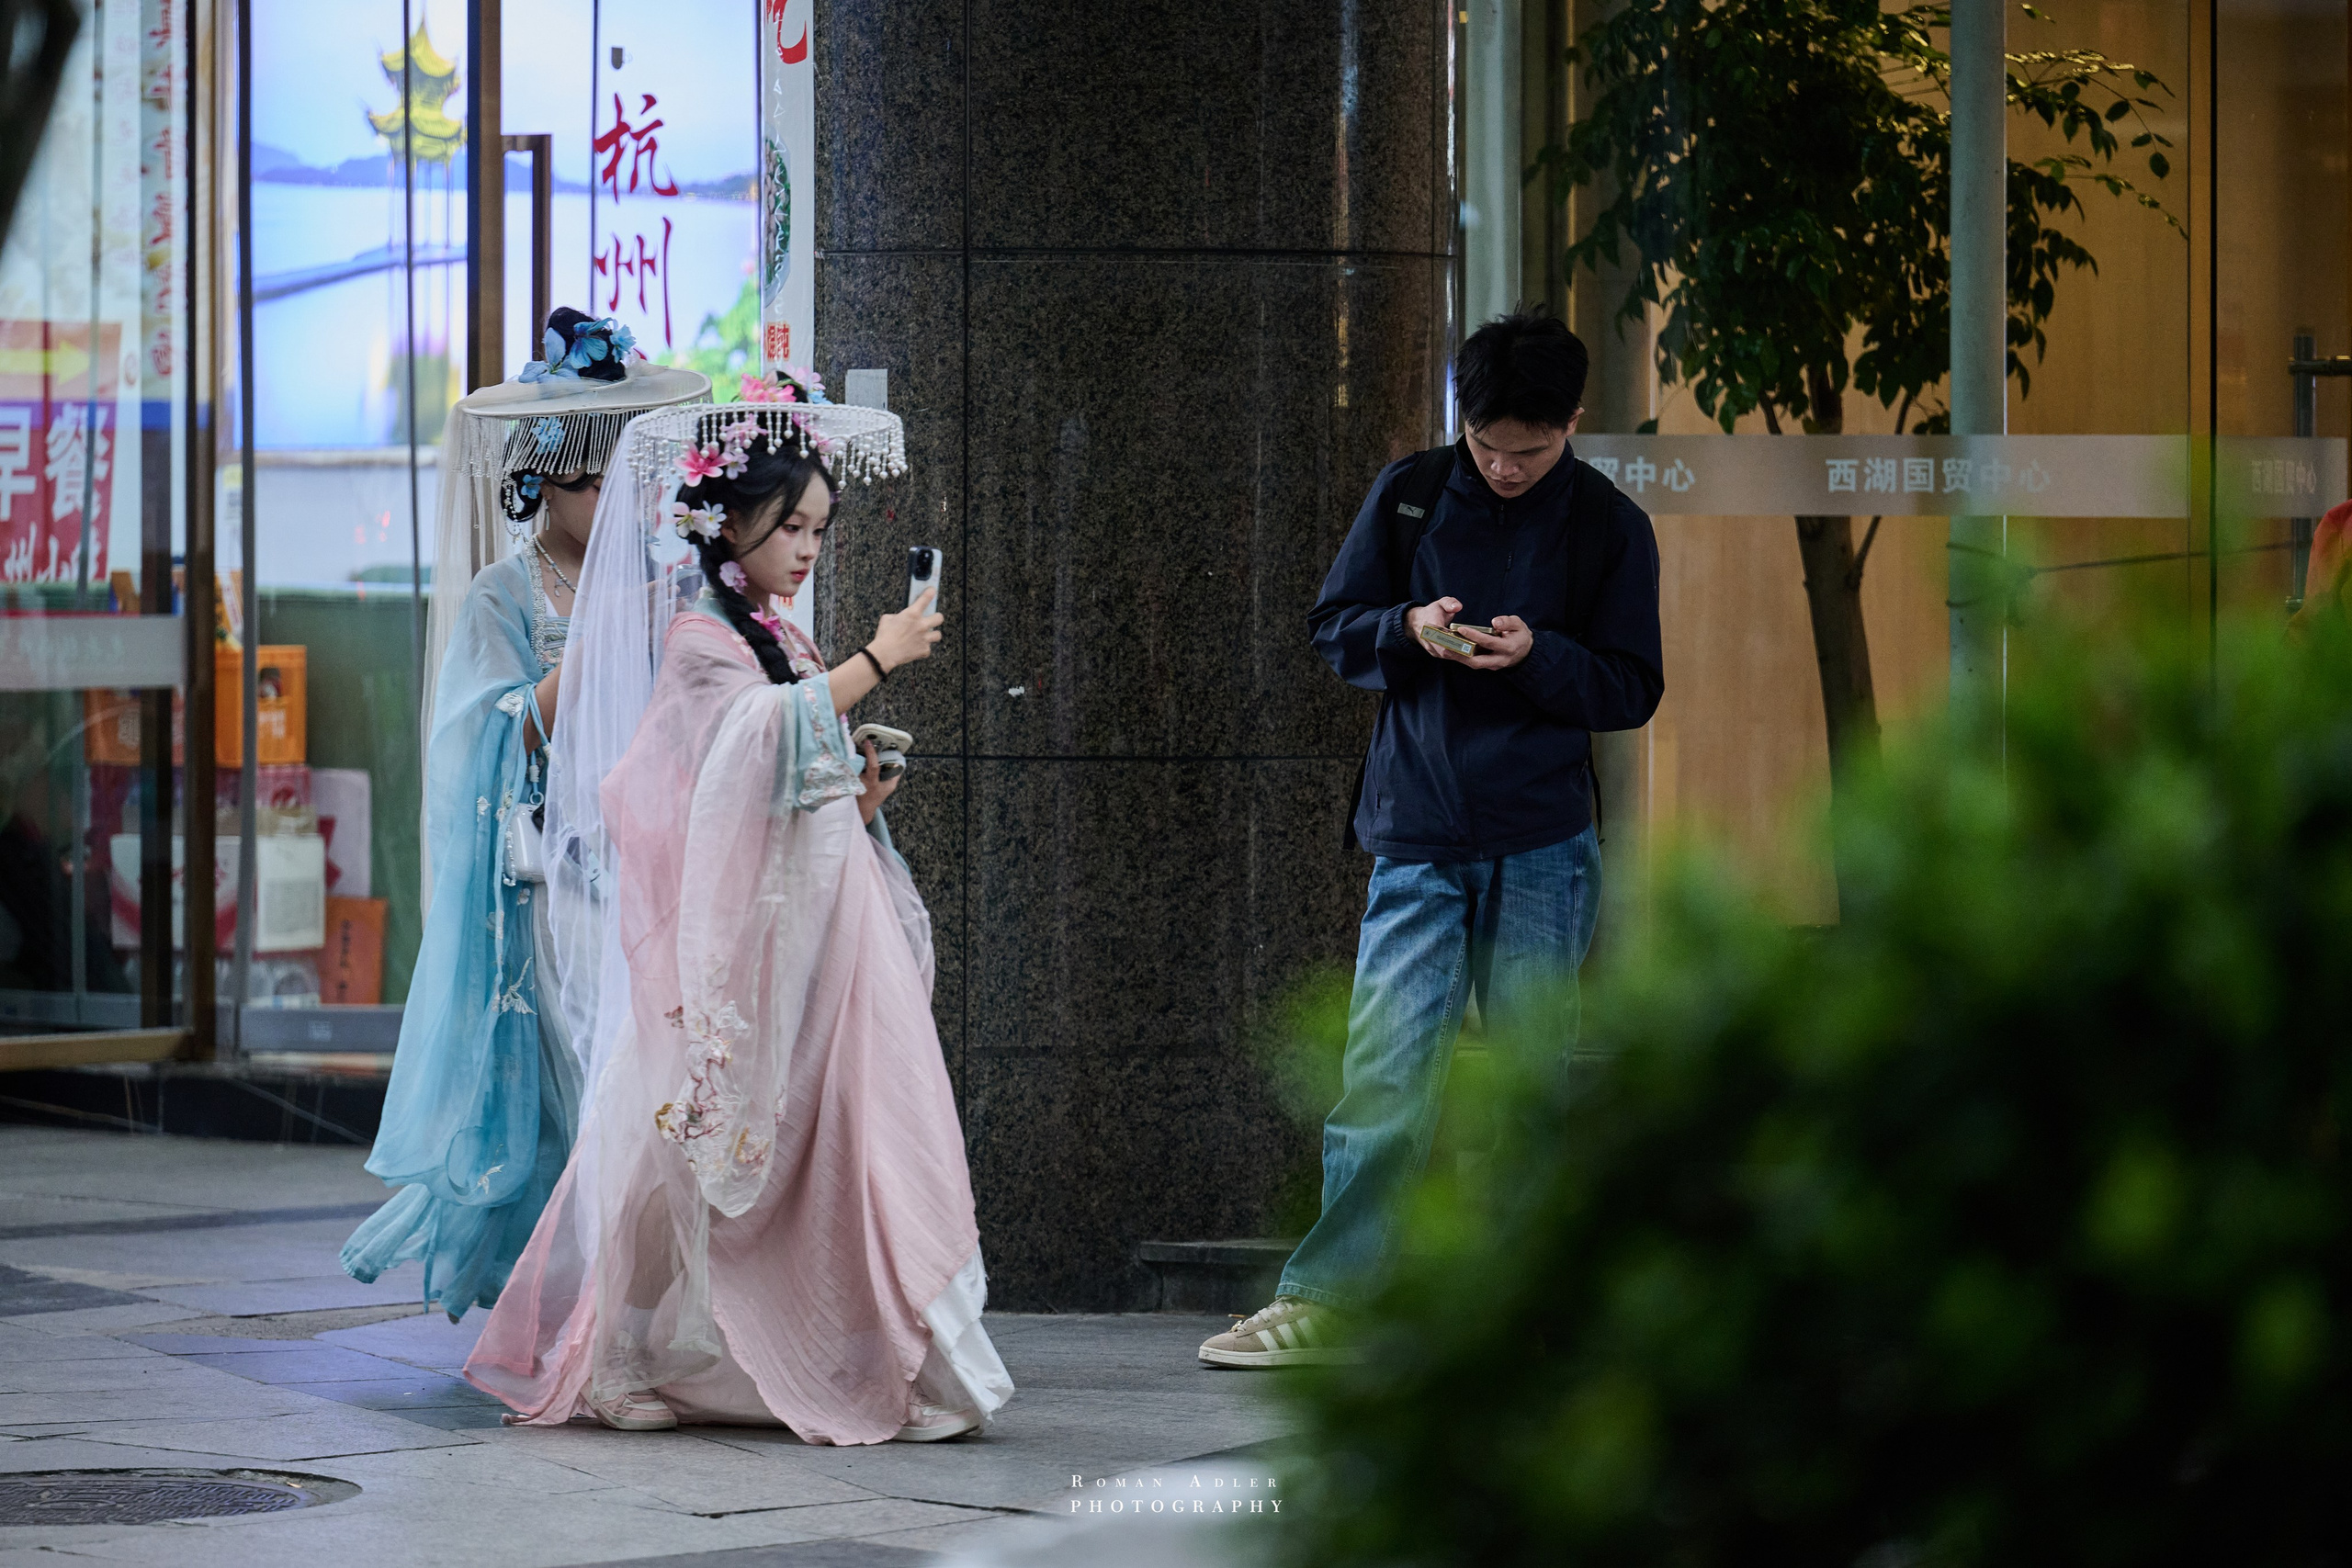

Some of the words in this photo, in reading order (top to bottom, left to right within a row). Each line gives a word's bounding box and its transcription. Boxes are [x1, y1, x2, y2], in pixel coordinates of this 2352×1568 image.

[593, 92, 679, 361] 杭州
[1825, 457, 2051, 494] 西湖国贸中心
